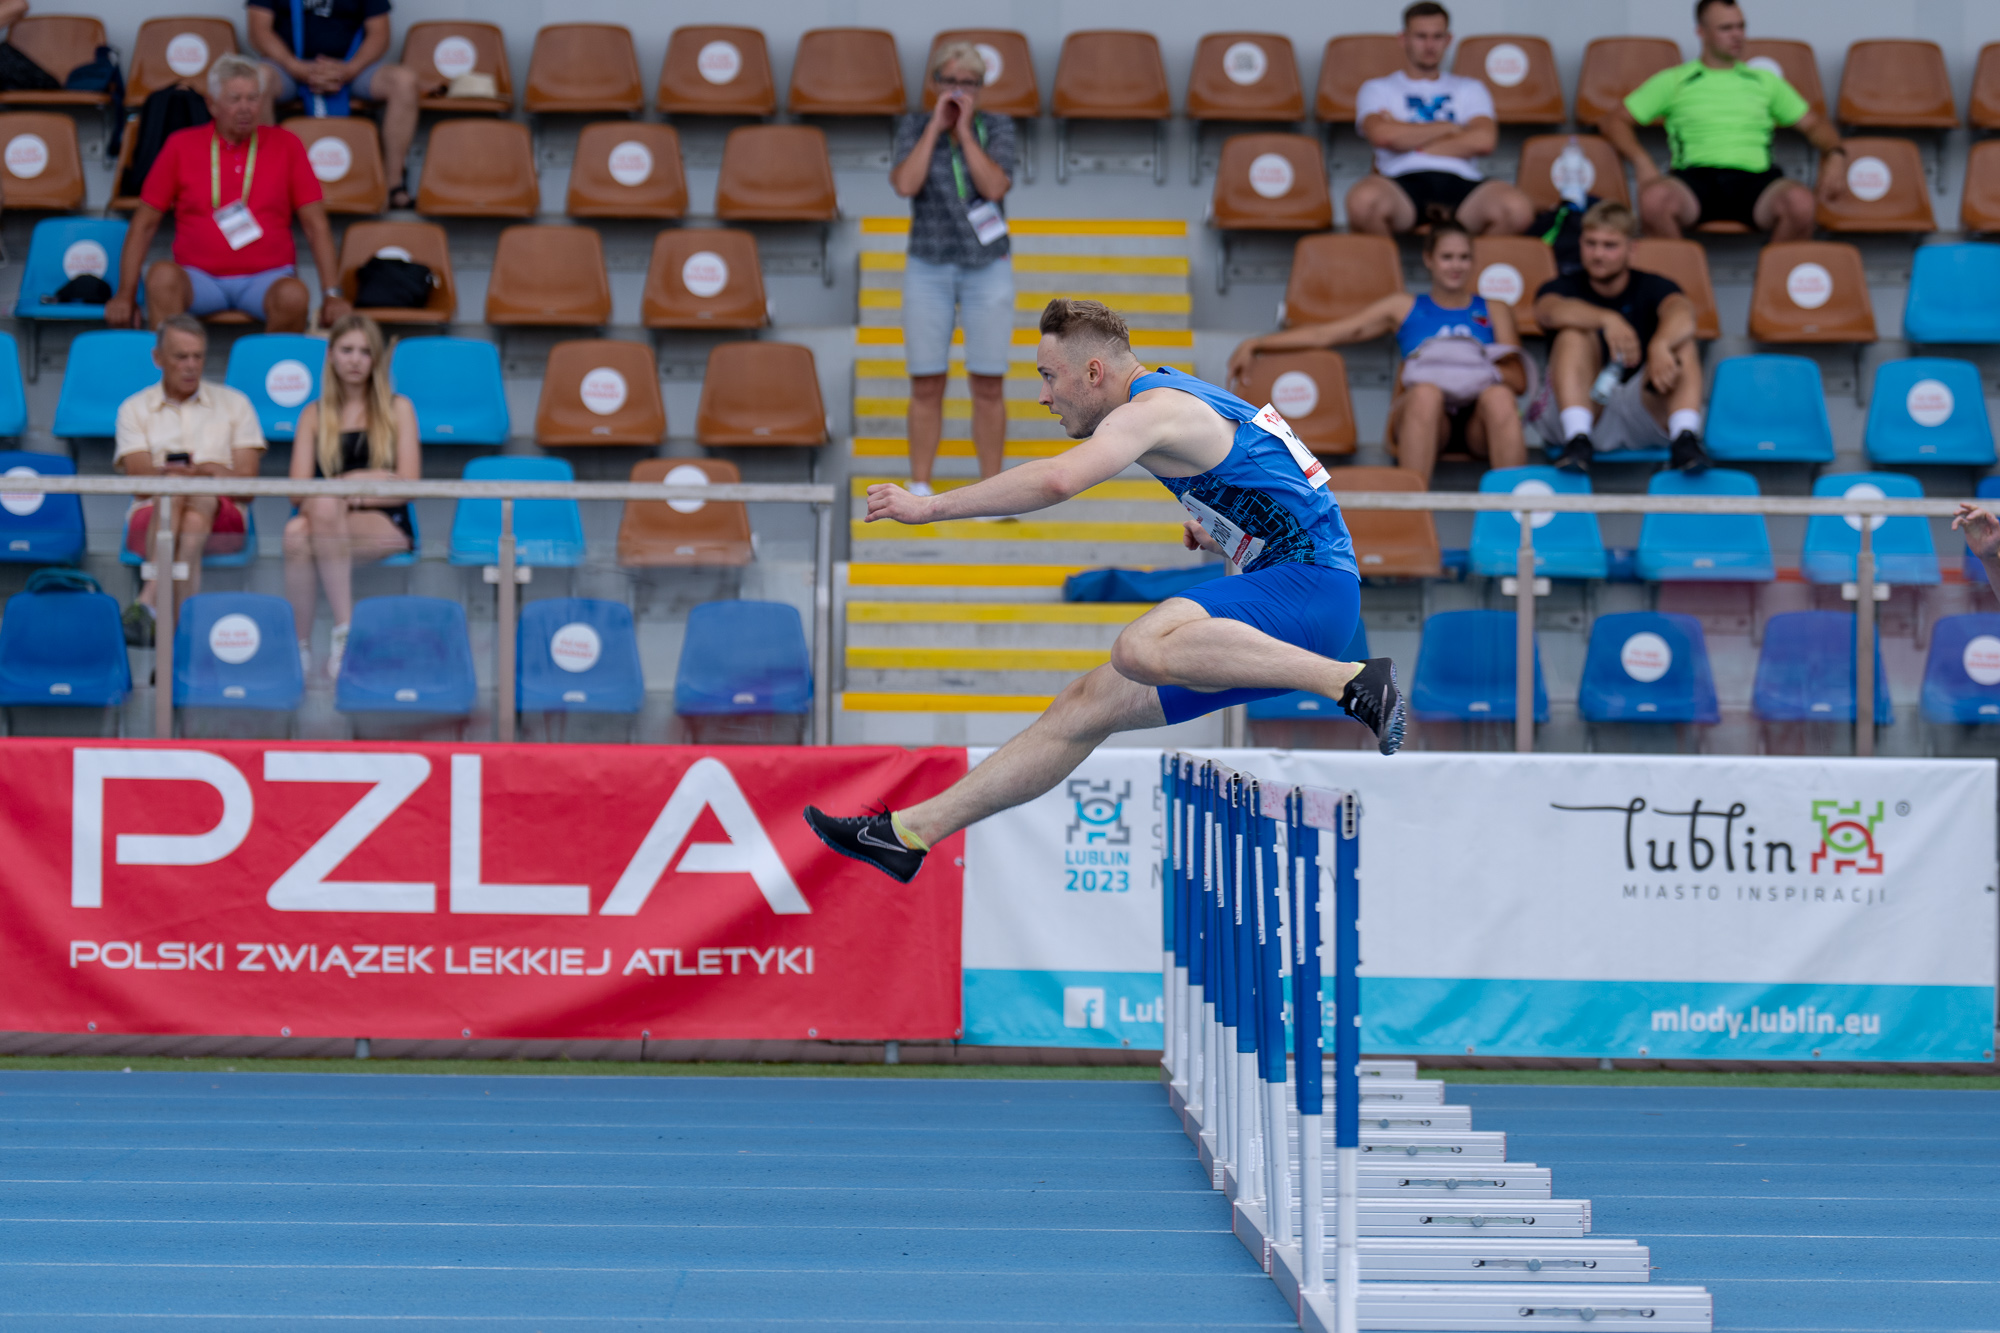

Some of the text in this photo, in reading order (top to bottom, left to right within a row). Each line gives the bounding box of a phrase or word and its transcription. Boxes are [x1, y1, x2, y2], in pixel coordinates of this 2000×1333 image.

[71, 748, 811, 916] PZLA
[1550, 797, 1796, 873] lublin
[1065, 850, 1130, 866] LUBLIN
[1065, 869, 1130, 892] 2023
[1623, 884, 1887, 905] MIASTO INSPIRACJI
[70, 940, 814, 978] POLSKI ZWIĄZEK LEKKIEJ ATLETYKI
[1651, 1005, 1880, 1039] mlody.lublin.eu
